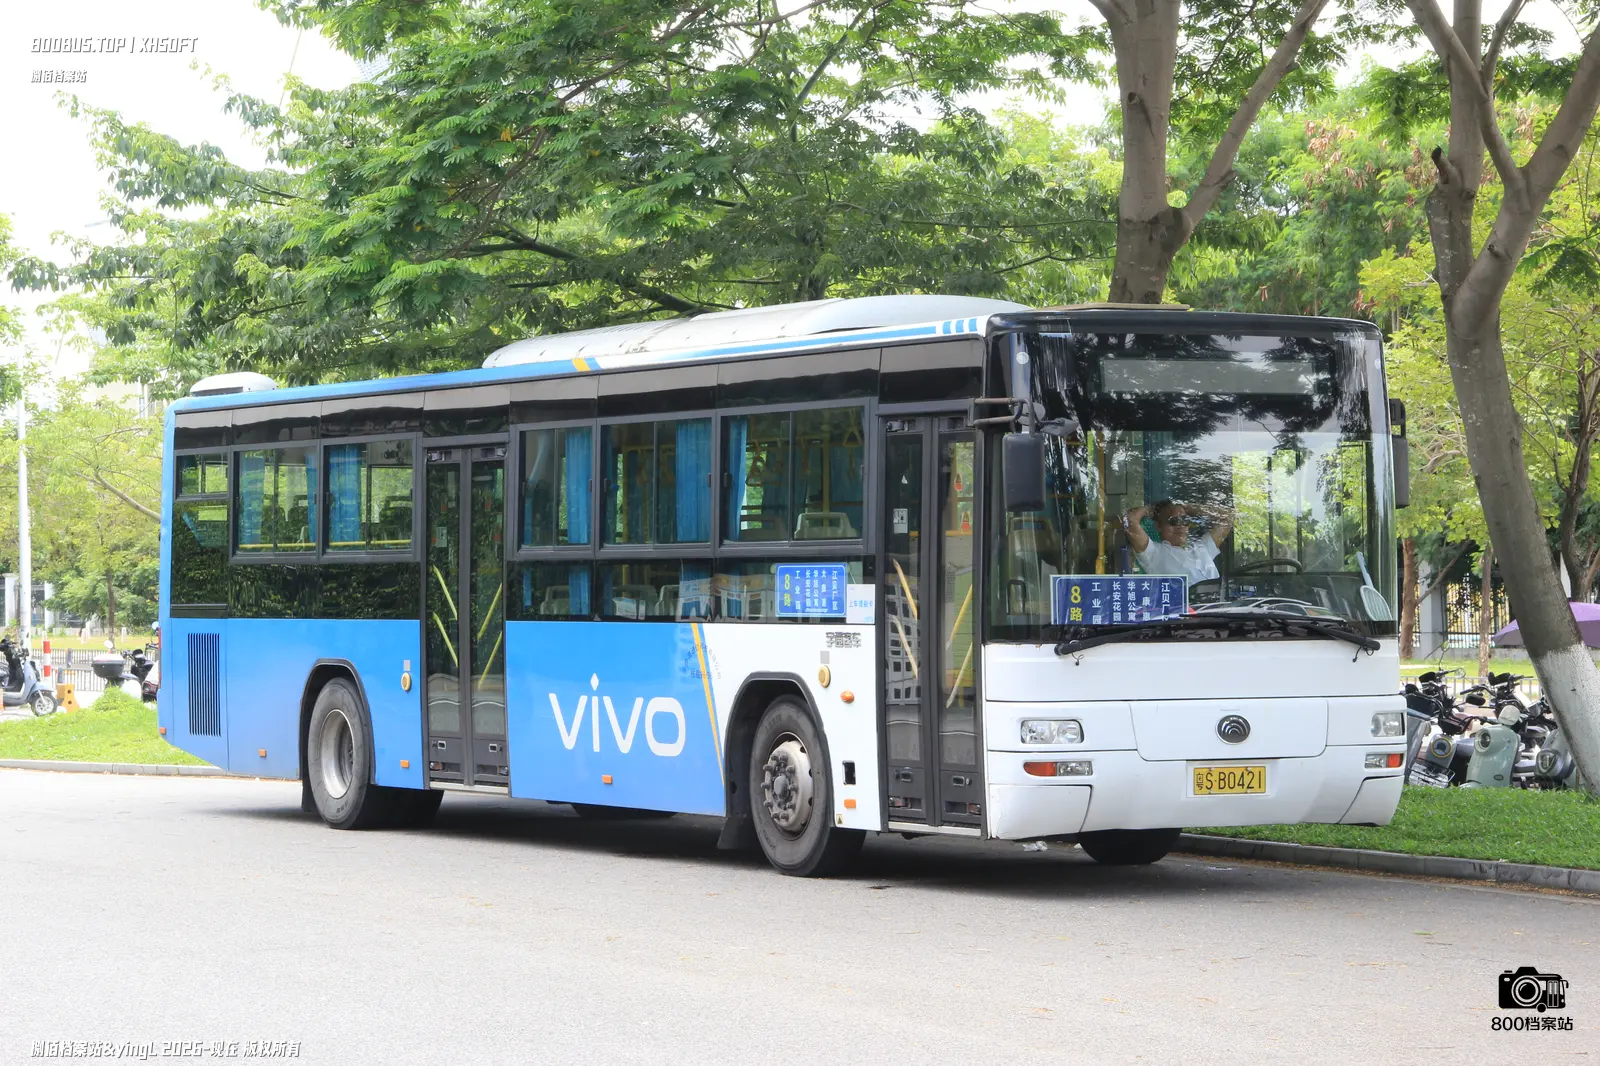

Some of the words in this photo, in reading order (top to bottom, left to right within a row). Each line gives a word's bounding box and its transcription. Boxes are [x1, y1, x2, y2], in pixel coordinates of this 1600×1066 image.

[1070, 586, 1083, 622] 8路
[1091, 582, 1102, 624] 工业园
[1112, 581, 1122, 622] 长安花园
[1127, 581, 1137, 622] 华旭公寓
[549, 672, 686, 757] vivo
